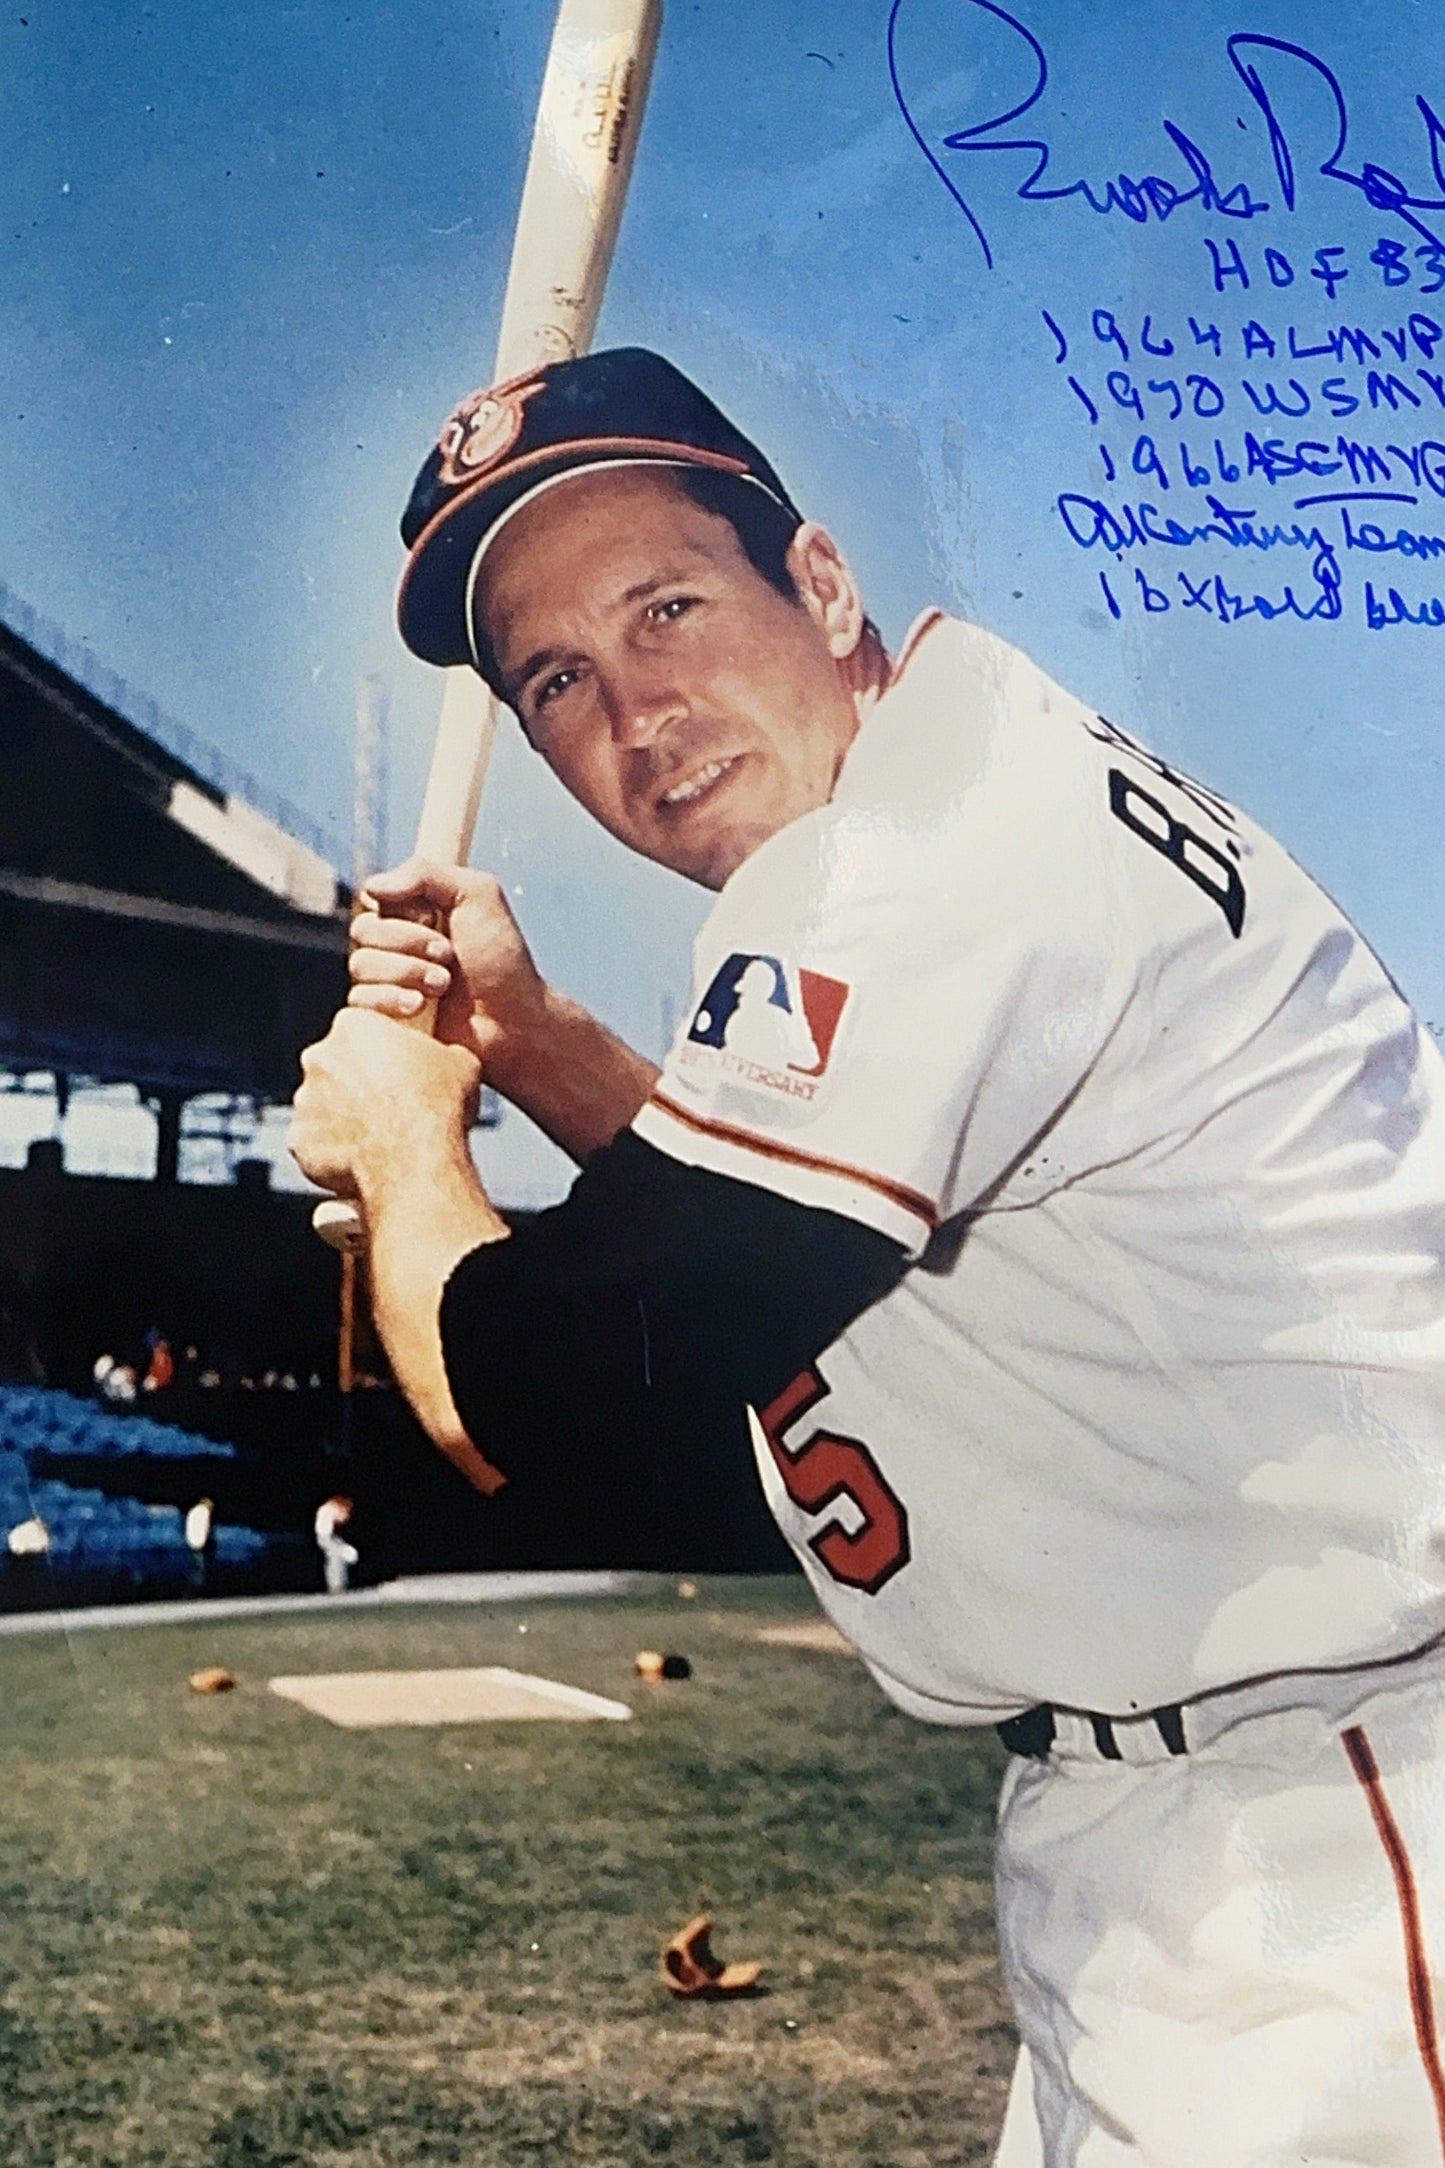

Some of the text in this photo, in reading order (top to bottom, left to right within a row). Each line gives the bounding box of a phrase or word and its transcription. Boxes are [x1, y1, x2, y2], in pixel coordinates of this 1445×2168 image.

[1203, 238, 1348, 298] HOF
[1041, 309, 1221, 363] 1964
[1067, 371, 1225, 424] 1970
[1100, 435, 1240, 489] 1966
[757, 1362, 912, 1597] 5
